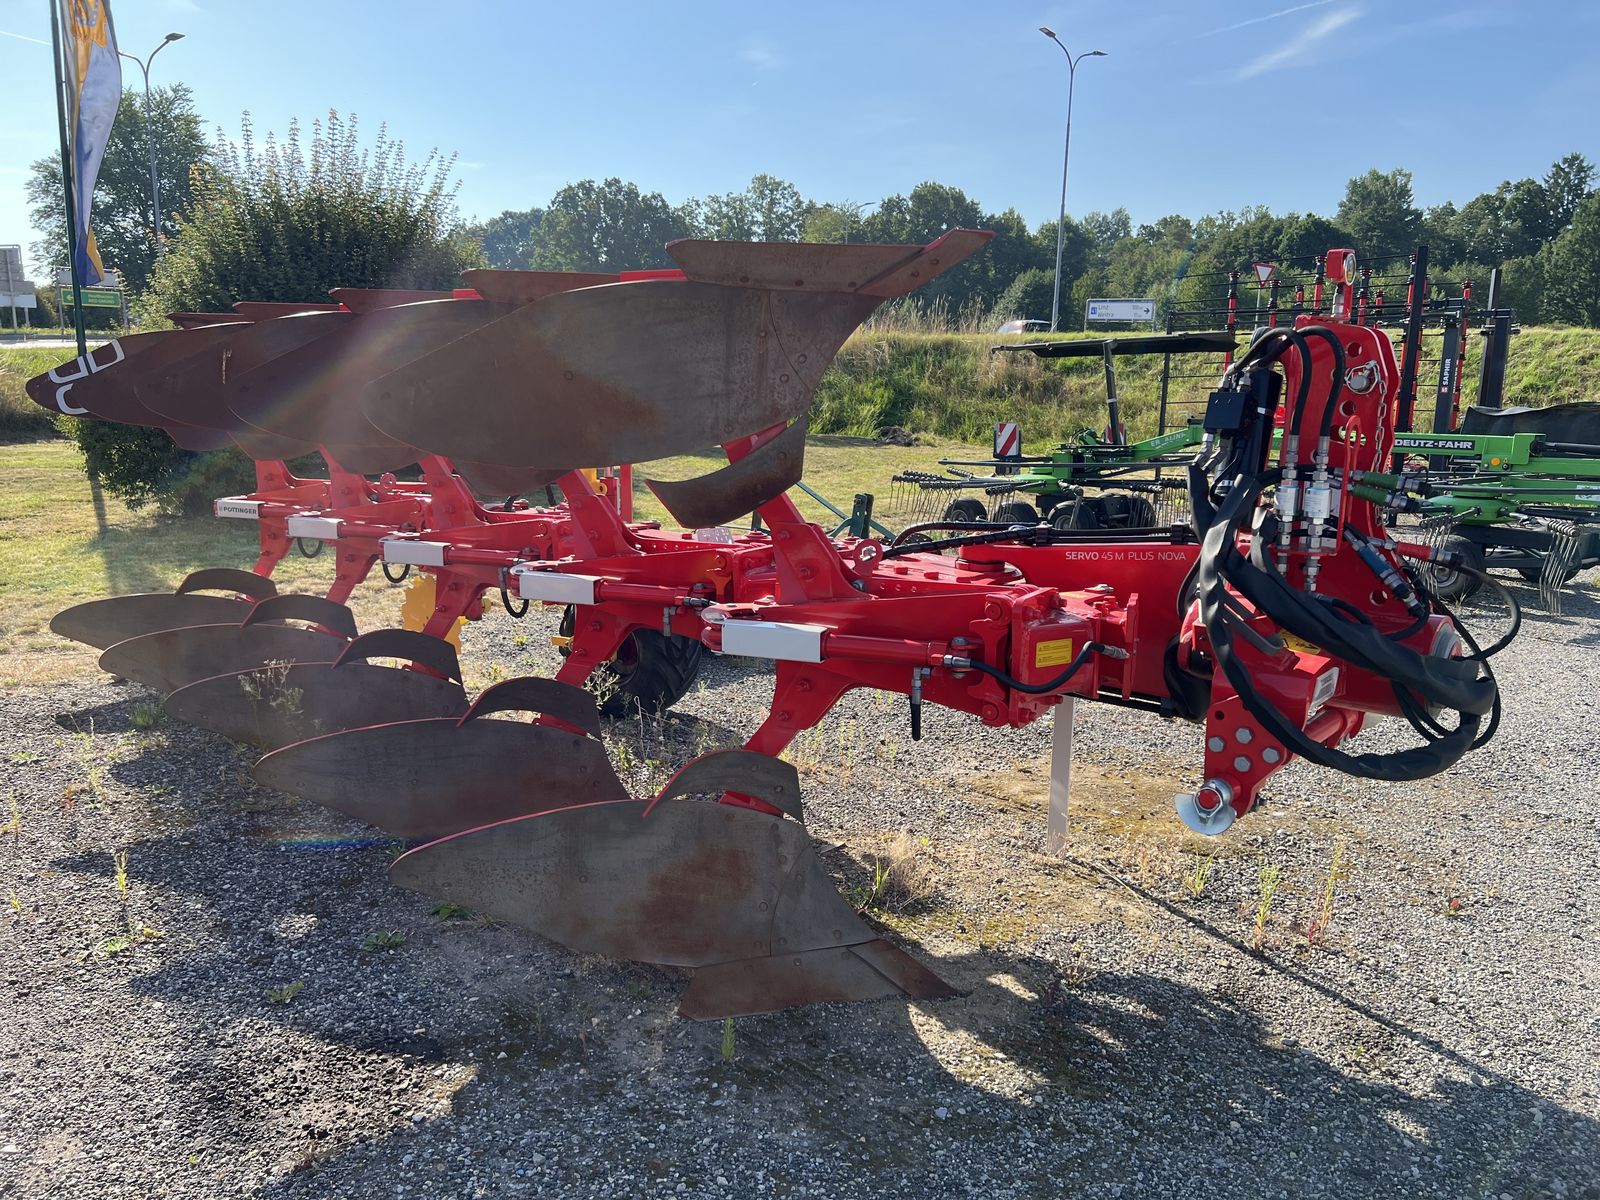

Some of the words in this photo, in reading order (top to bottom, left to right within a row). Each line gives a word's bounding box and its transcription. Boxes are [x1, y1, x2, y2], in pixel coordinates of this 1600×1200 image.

[1442, 358, 1452, 386] SAPHIR
[1394, 439, 1473, 449] DEUTZ-FAHR
[1065, 551, 1099, 560] SERVO
[1128, 551, 1154, 560] PLUS
[1157, 551, 1186, 560] NOVA
